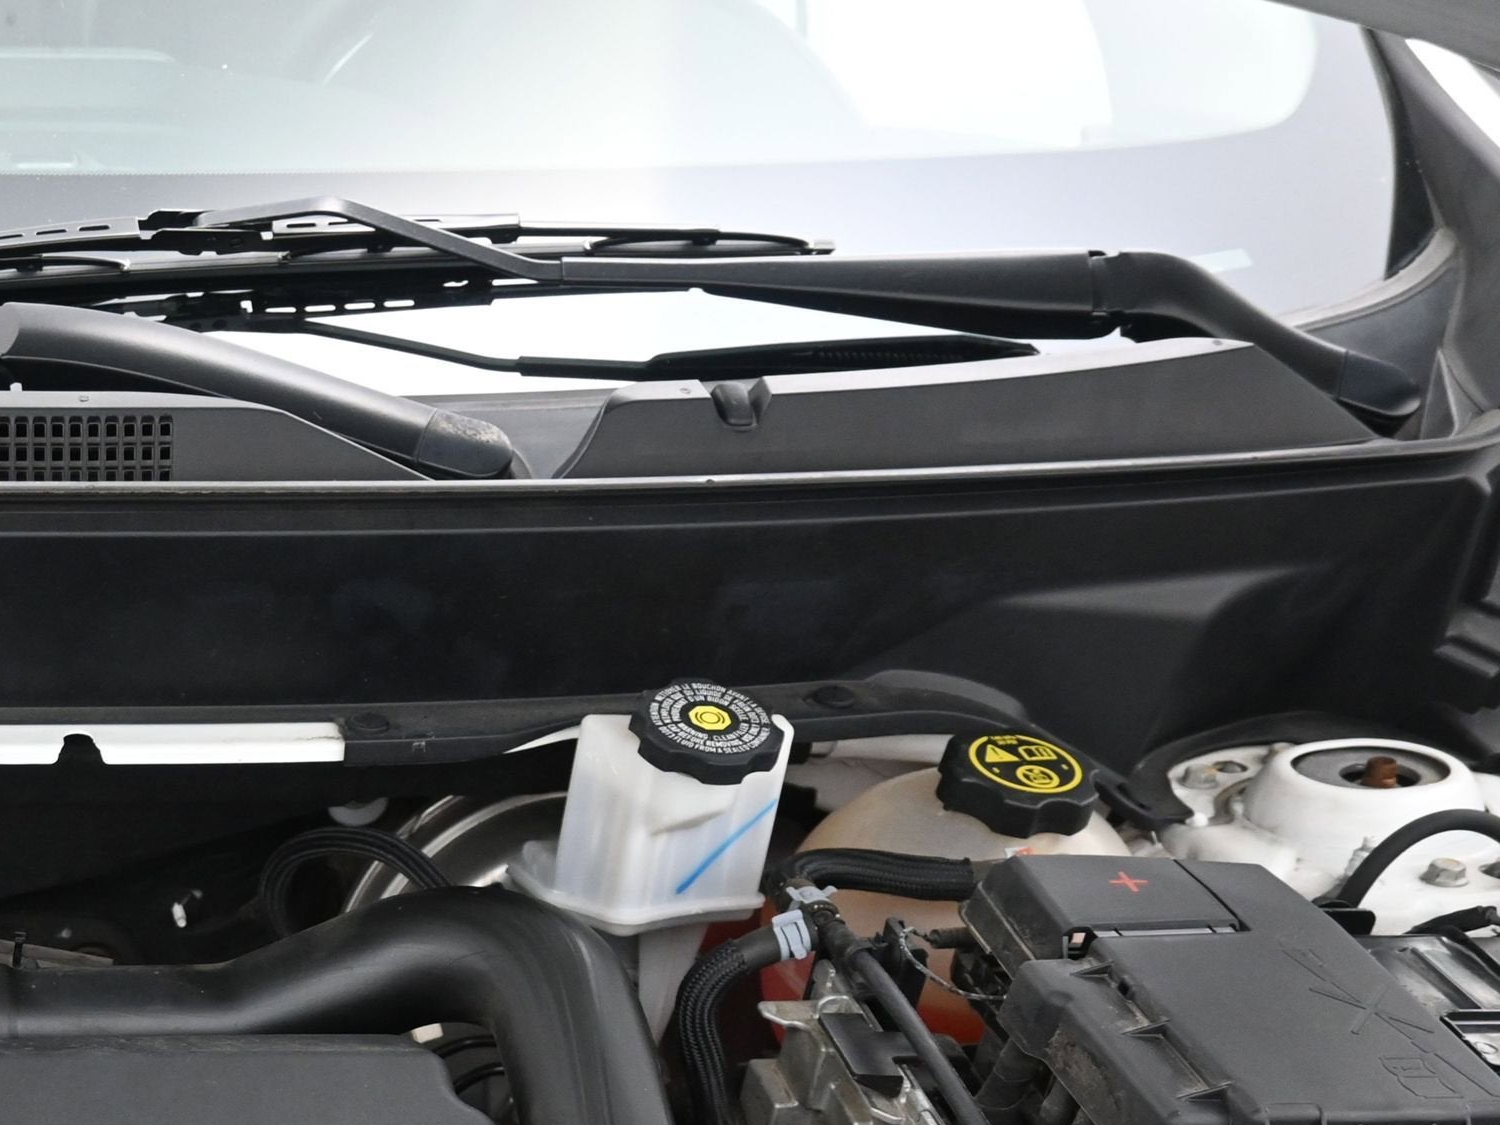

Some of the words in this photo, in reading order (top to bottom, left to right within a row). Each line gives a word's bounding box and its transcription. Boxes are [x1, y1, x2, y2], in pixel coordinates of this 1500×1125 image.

[690, 682, 727, 693] BOUCHON
[672, 736, 695, 748] FLUID
[694, 744, 717, 753] FROM
